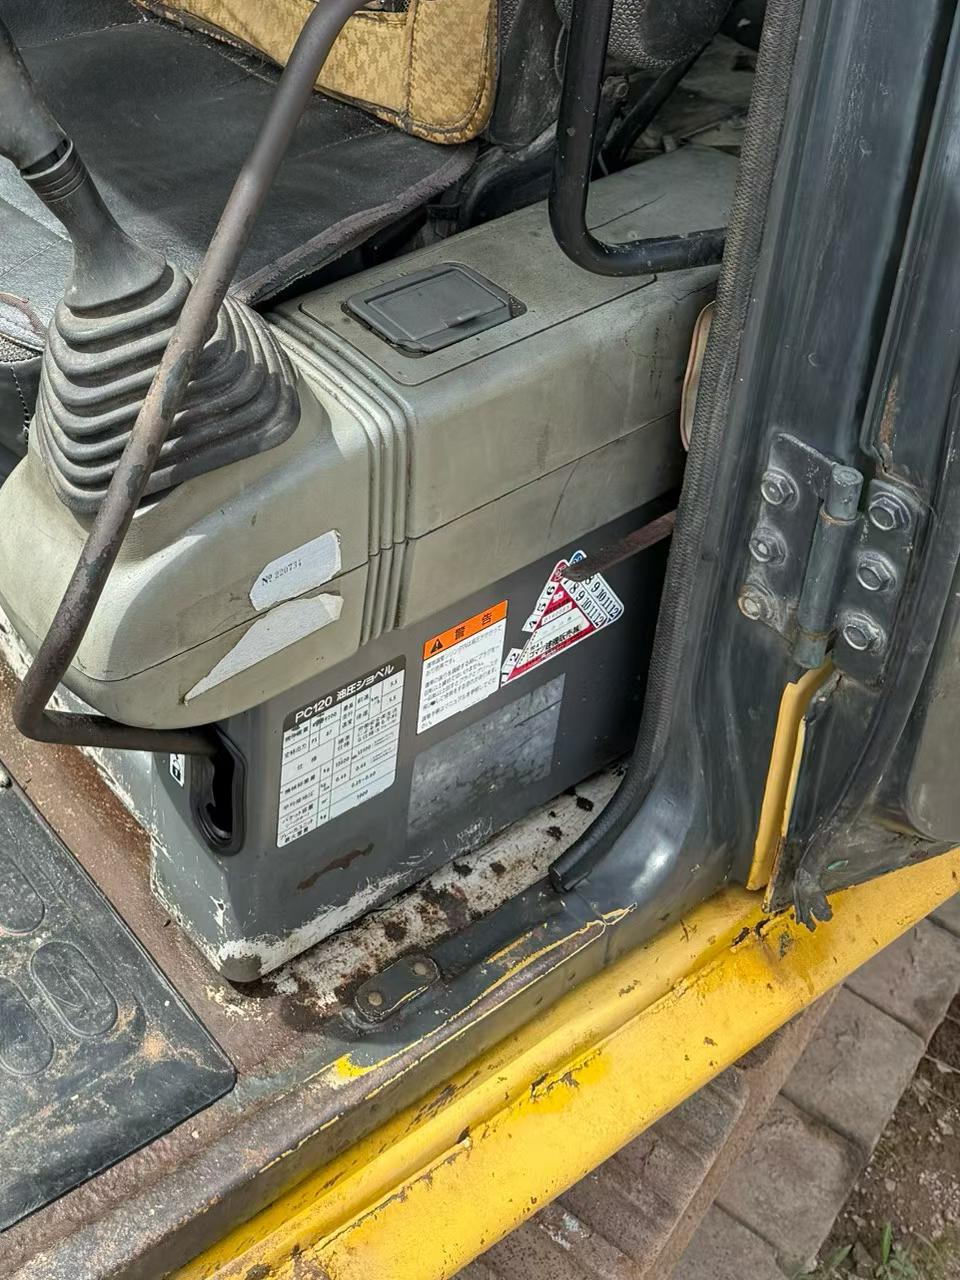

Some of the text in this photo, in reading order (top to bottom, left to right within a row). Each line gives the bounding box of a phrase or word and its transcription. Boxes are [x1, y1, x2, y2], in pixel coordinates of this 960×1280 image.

[295, 695, 333, 723] PC120
[337, 664, 395, 702] 油圧ショベル
